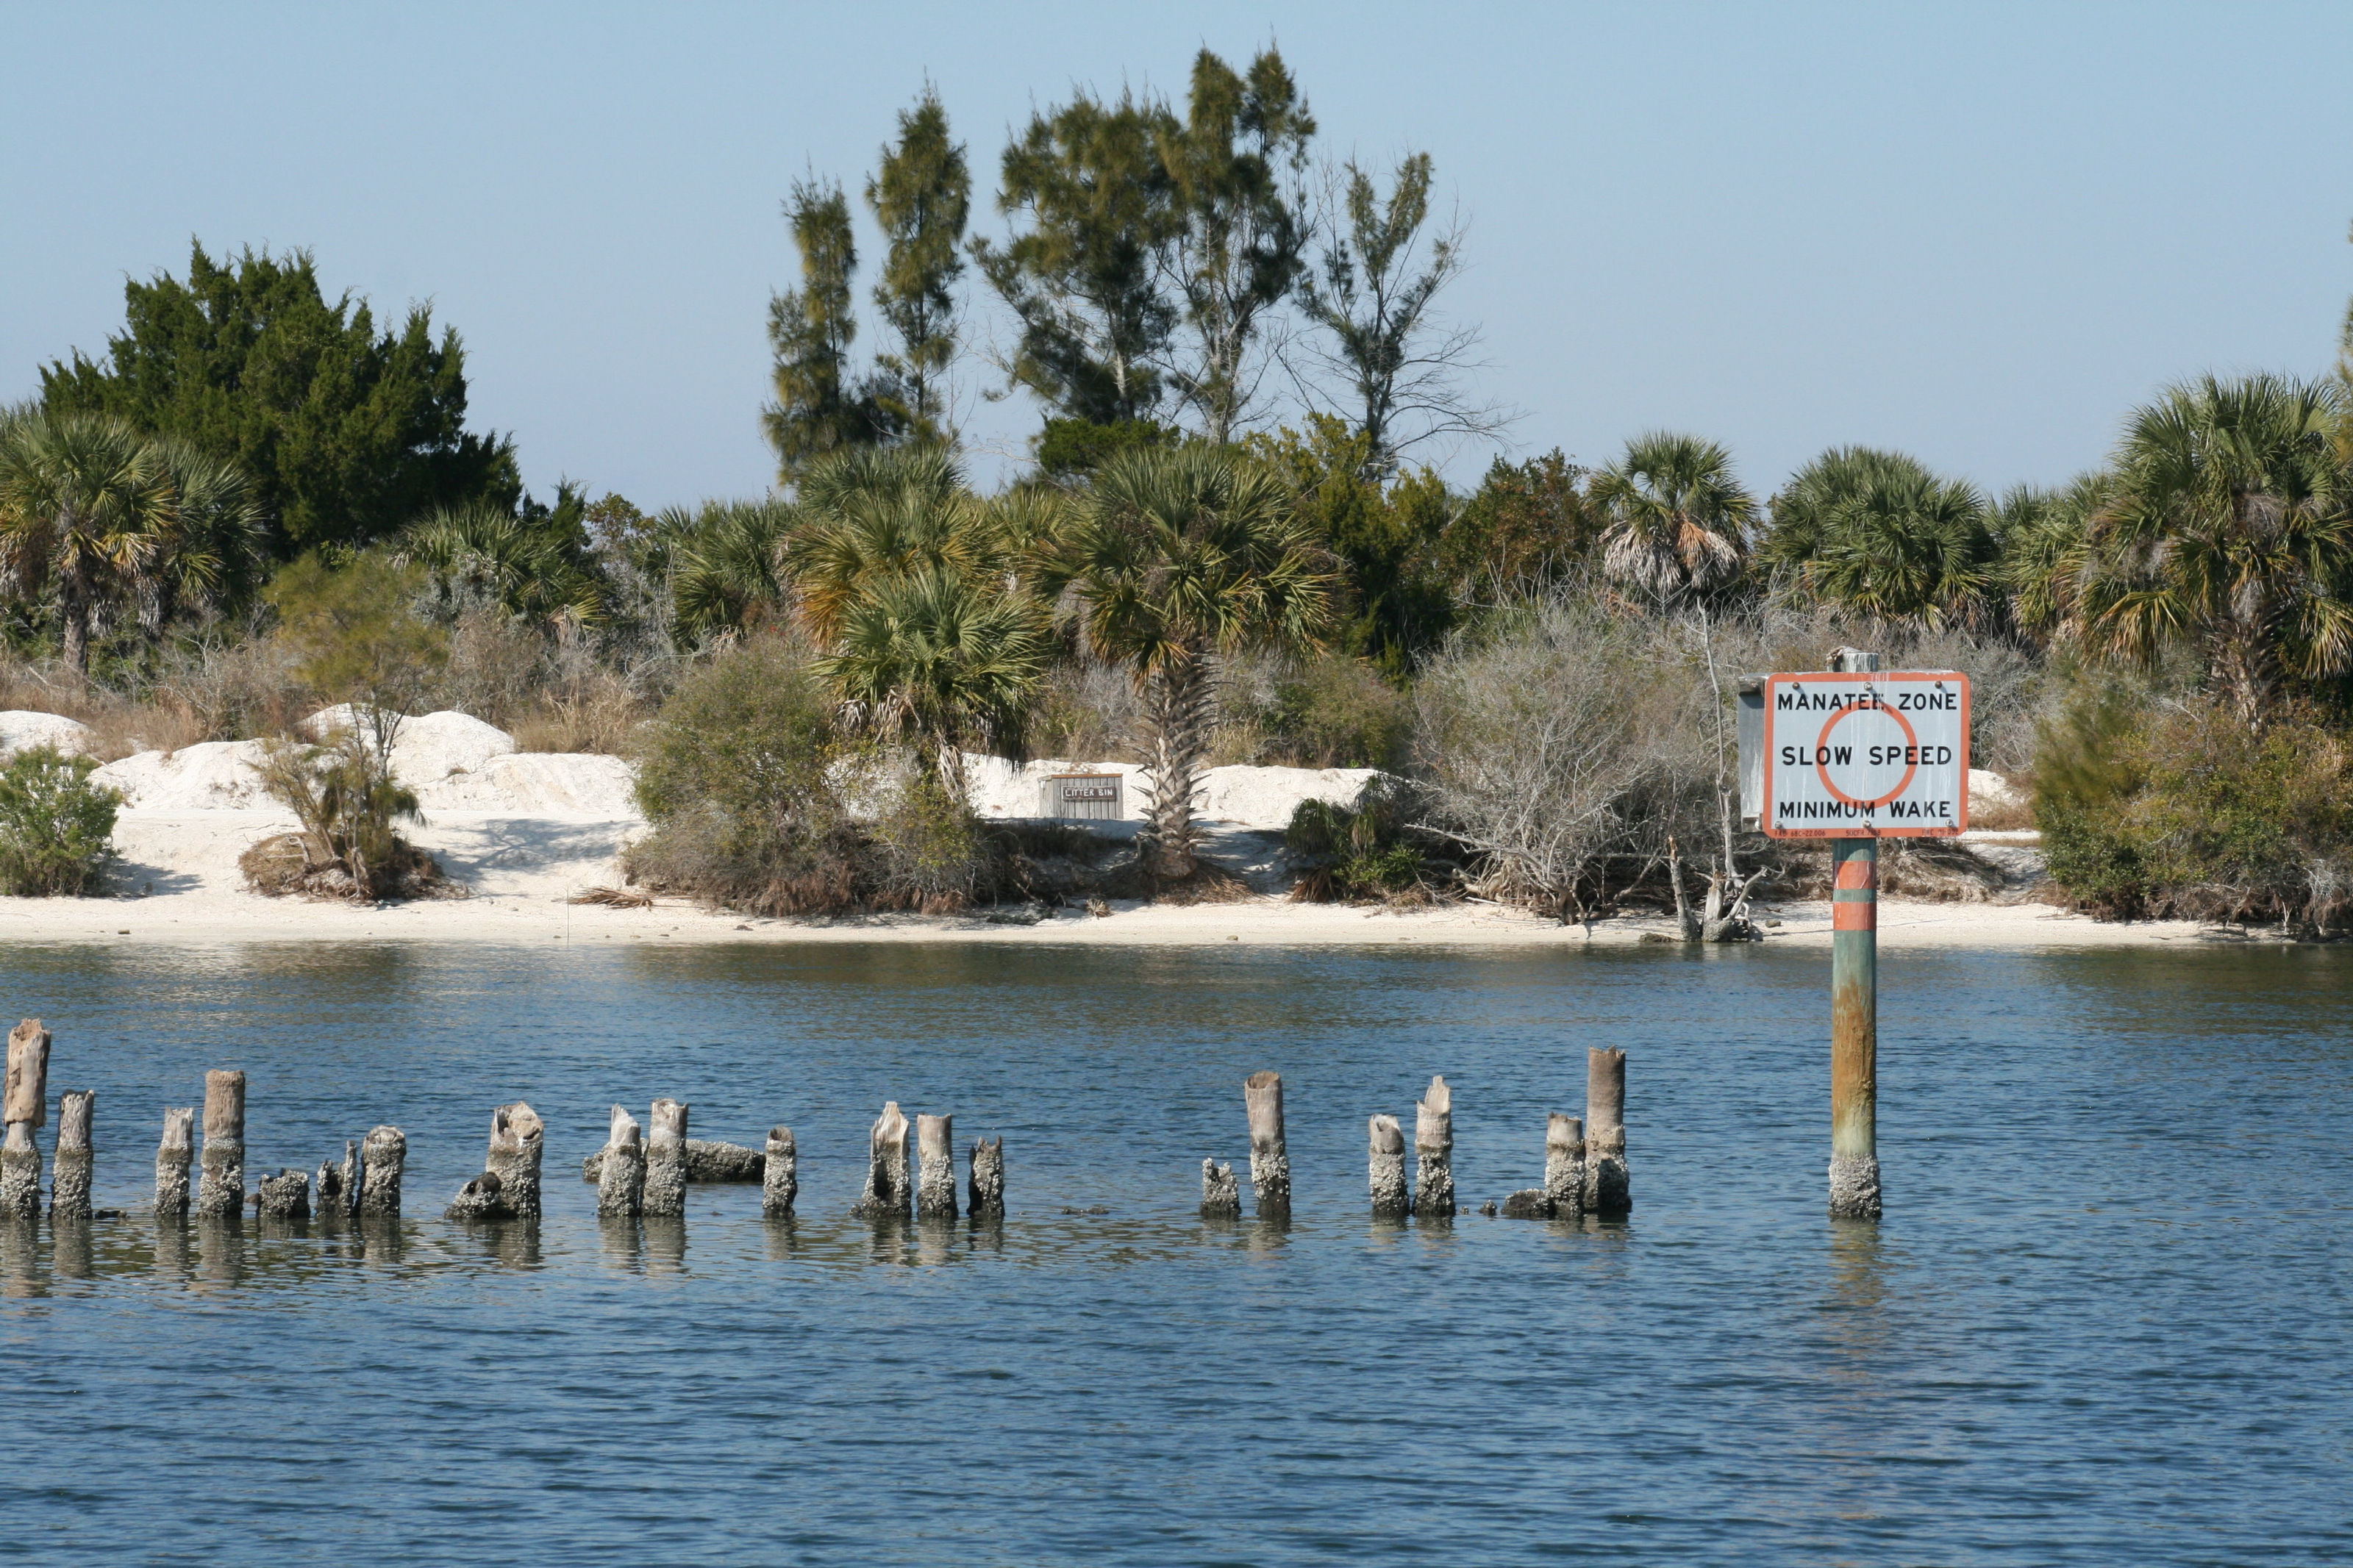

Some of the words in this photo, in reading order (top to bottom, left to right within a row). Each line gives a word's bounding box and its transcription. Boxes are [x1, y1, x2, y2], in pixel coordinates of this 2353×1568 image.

[1777, 693, 1885, 711] MANATEE
[1899, 693, 1957, 710] ZONE
[1782, 746, 1853, 765] SLOW
[1869, 746, 1952, 765] SPEED
[1065, 788, 1094, 796] LITTER
[1098, 788, 1113, 796] BIN
[1779, 801, 1876, 818] MINIMUM
[1889, 801, 1951, 817] WAKE
